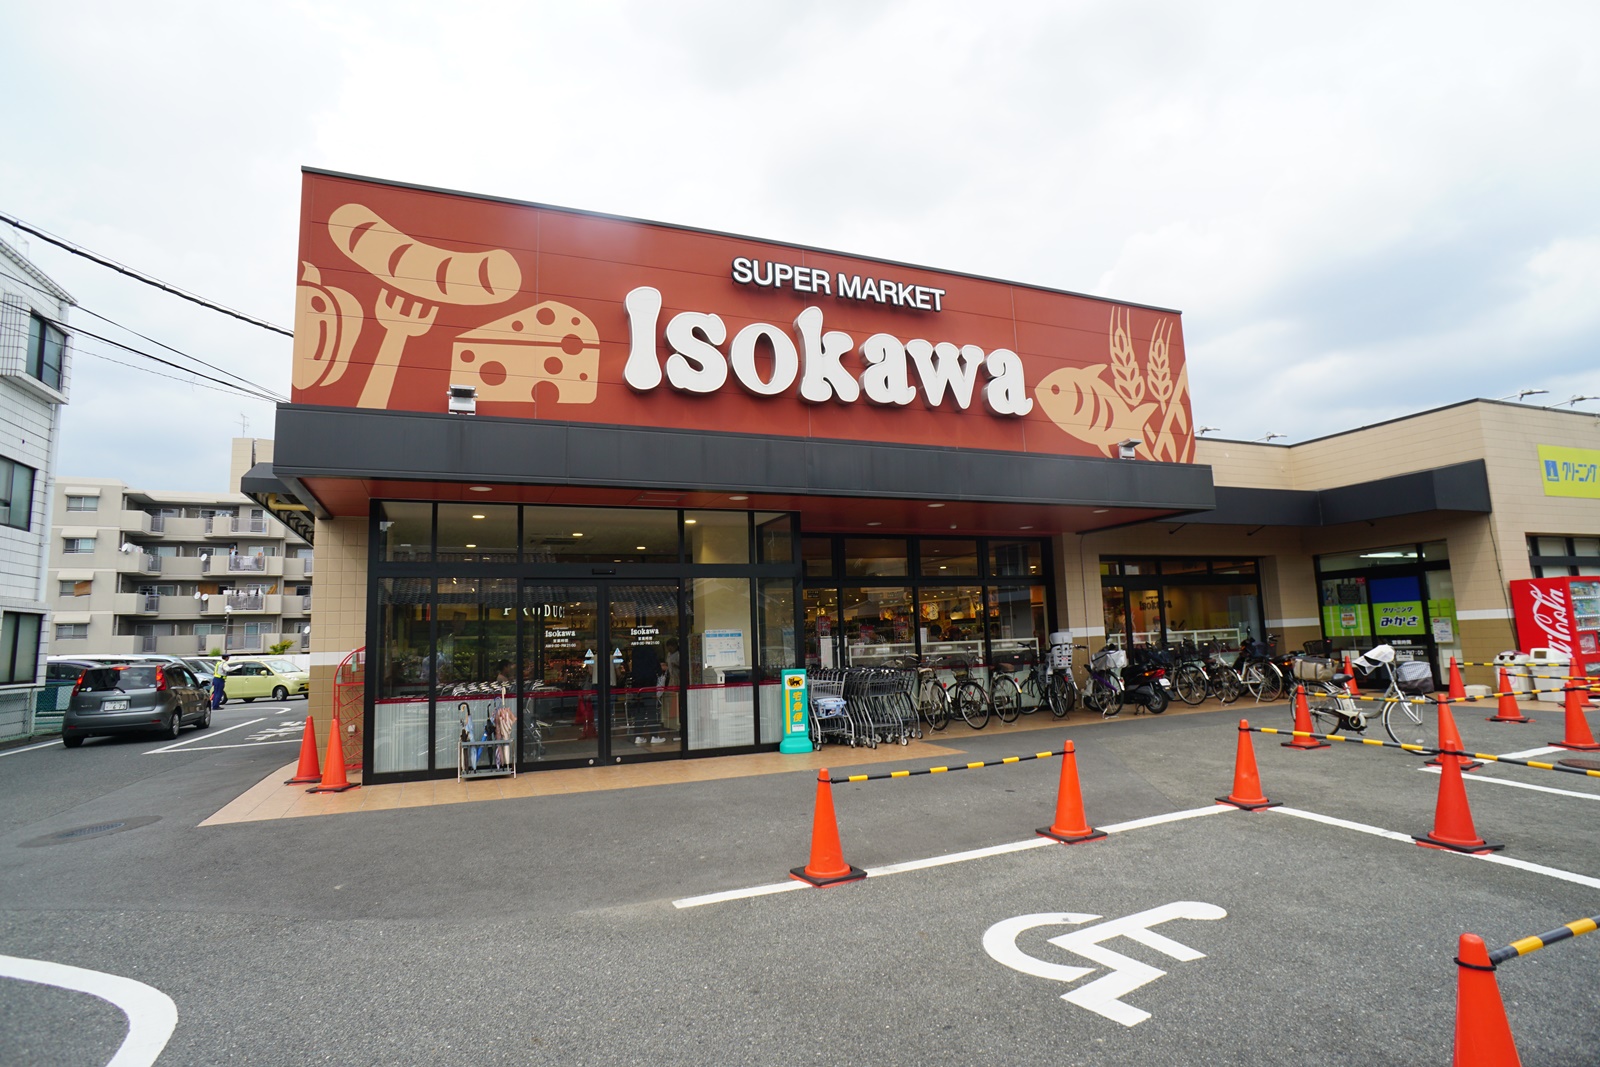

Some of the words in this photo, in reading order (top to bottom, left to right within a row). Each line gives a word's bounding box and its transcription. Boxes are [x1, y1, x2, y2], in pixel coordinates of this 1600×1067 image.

[733, 256, 831, 295] SUPER
[838, 272, 946, 313] MARKET
[623, 286, 1033, 416] Isokawa
[1562, 461, 1598, 483] クリーニング
[1139, 600, 1172, 610] Isoka
[1383, 606, 1414, 614] クリーニング
[1381, 616, 1419, 627] みかさ
[1529, 582, 1574, 659] a-Cola
[792, 691, 803, 722] 宅急便
